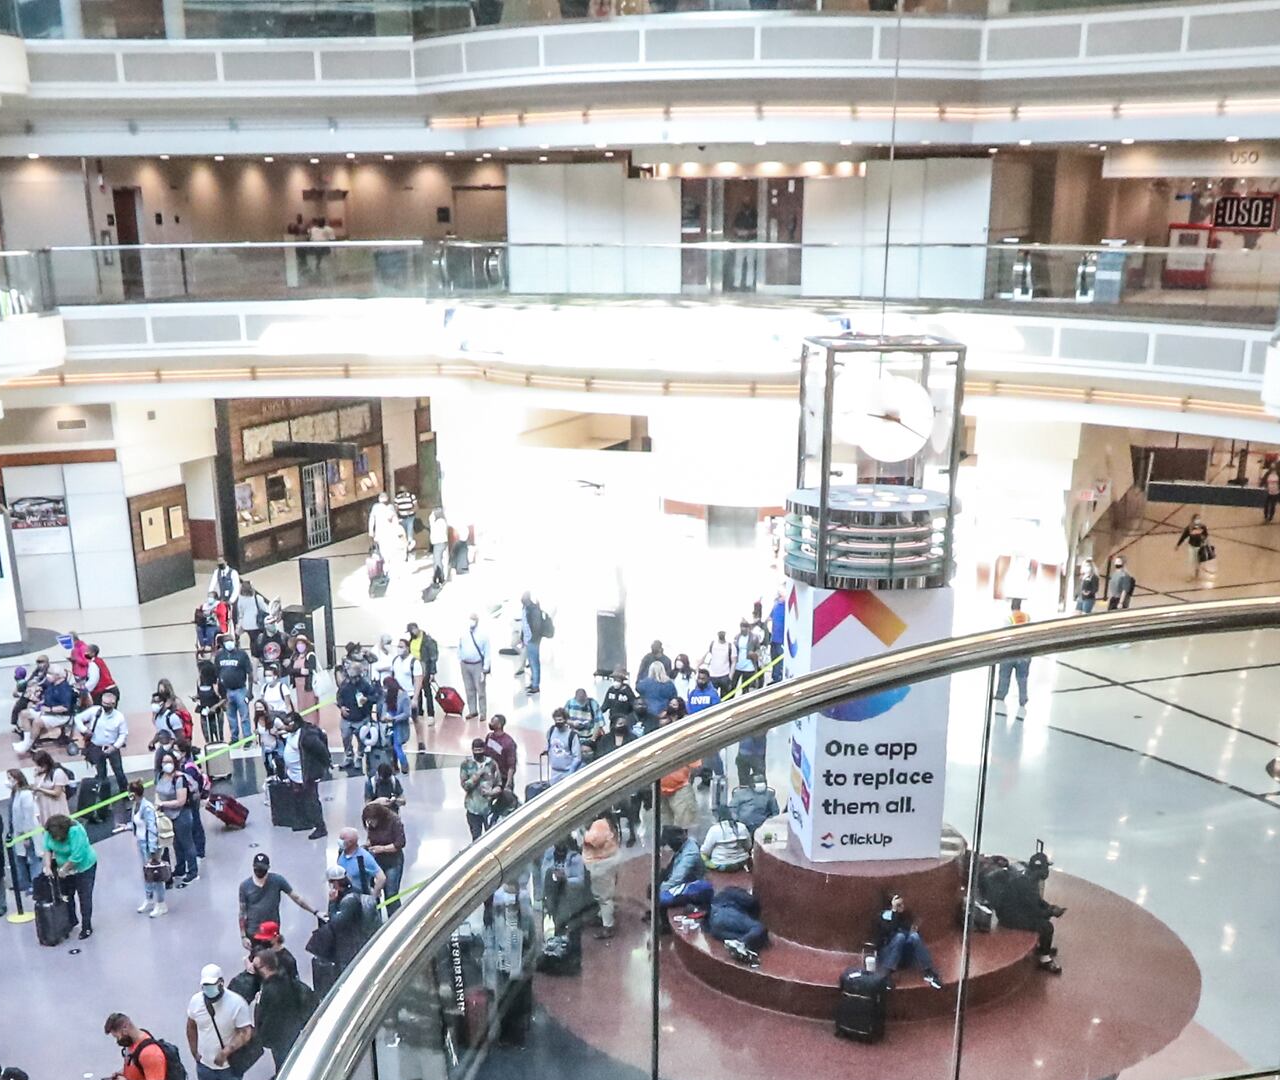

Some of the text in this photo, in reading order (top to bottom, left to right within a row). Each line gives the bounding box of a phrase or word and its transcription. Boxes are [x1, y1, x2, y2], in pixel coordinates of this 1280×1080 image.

[1229, 151, 1260, 164] USO
[1224, 199, 1264, 225] USO
[825, 739, 918, 760] One app
[822, 768, 934, 790] to replace
[821, 798, 880, 815] them
[885, 796, 916, 814] all.
[840, 832, 893, 847] ClickUp
